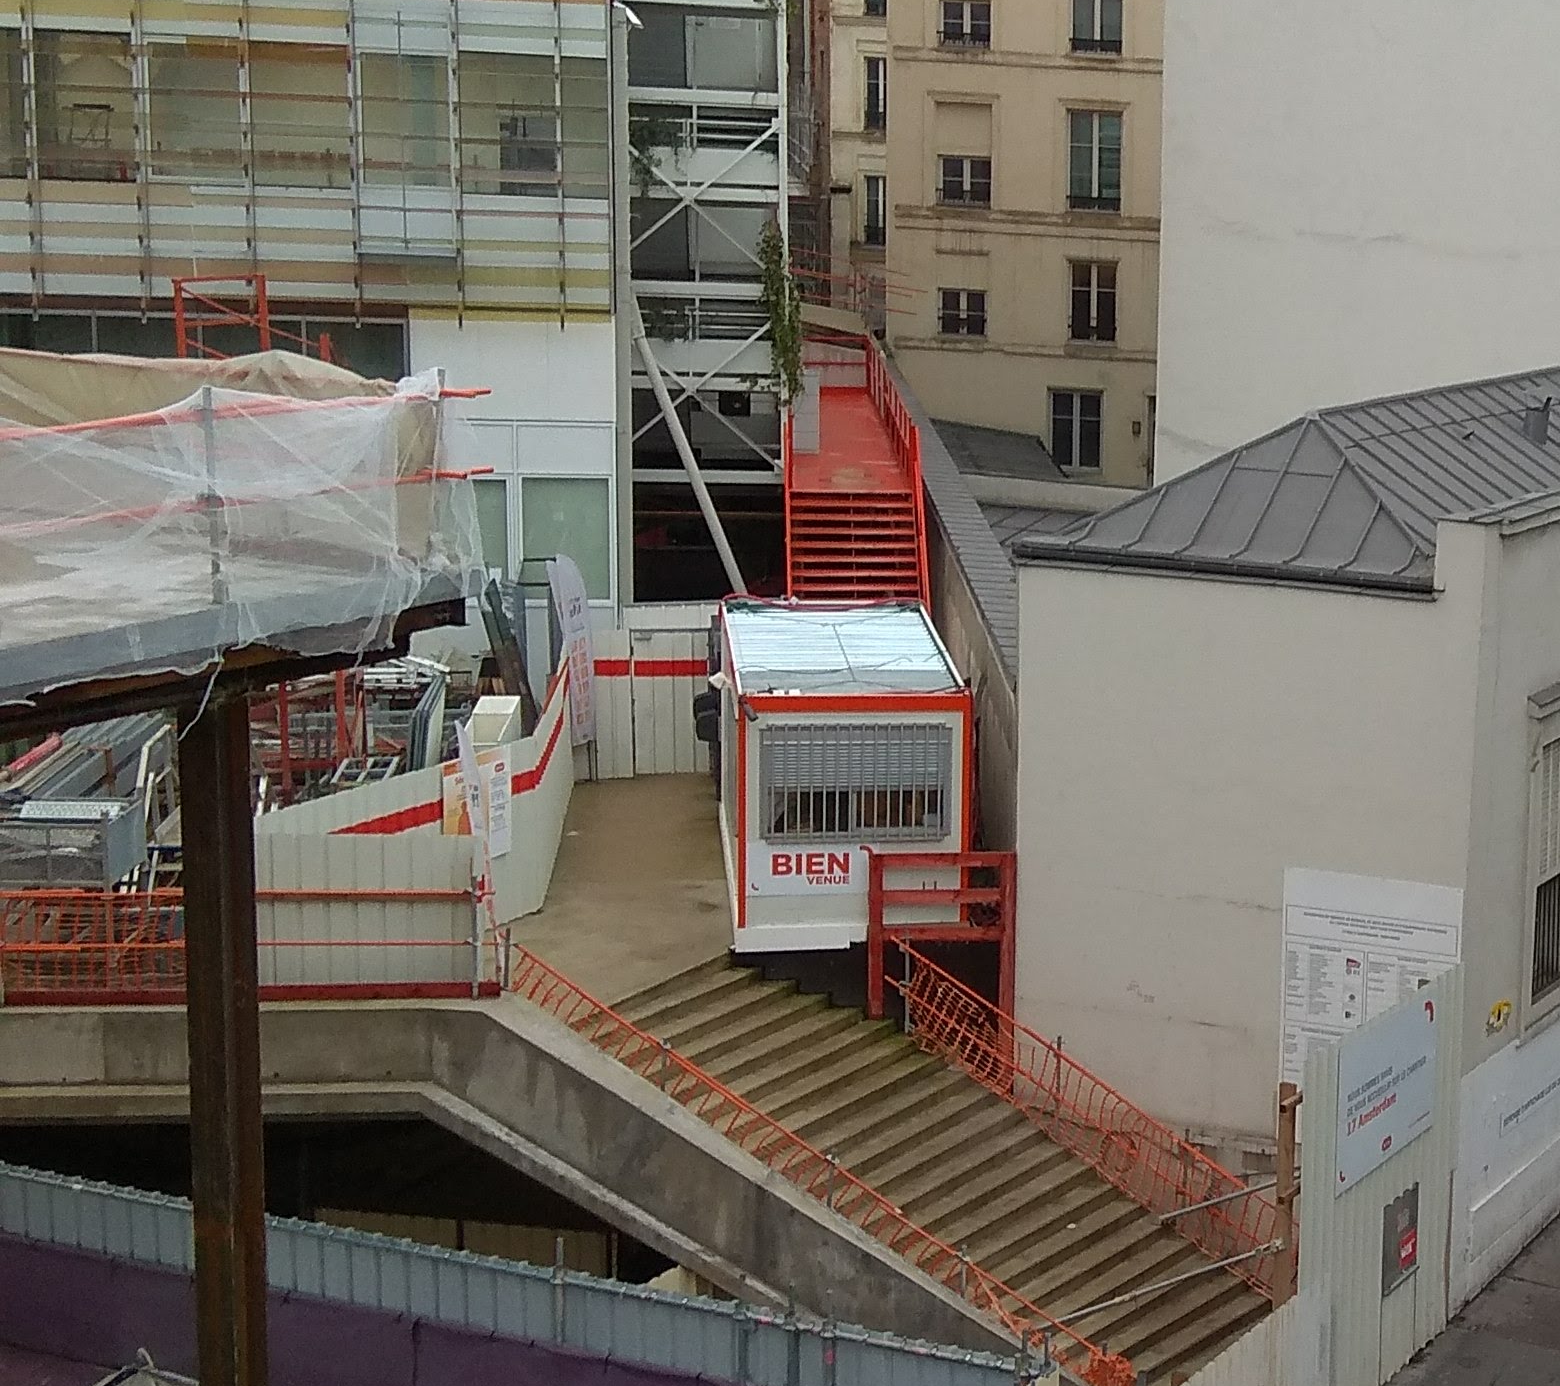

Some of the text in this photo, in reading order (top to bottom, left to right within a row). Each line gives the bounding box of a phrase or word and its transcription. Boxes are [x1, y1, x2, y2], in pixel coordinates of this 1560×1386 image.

[771, 852, 850, 875] BIEN
[806, 875, 850, 885] VENUE
[1346, 1117, 1357, 1136] 17
[1358, 1092, 1397, 1128] Amsterdam
